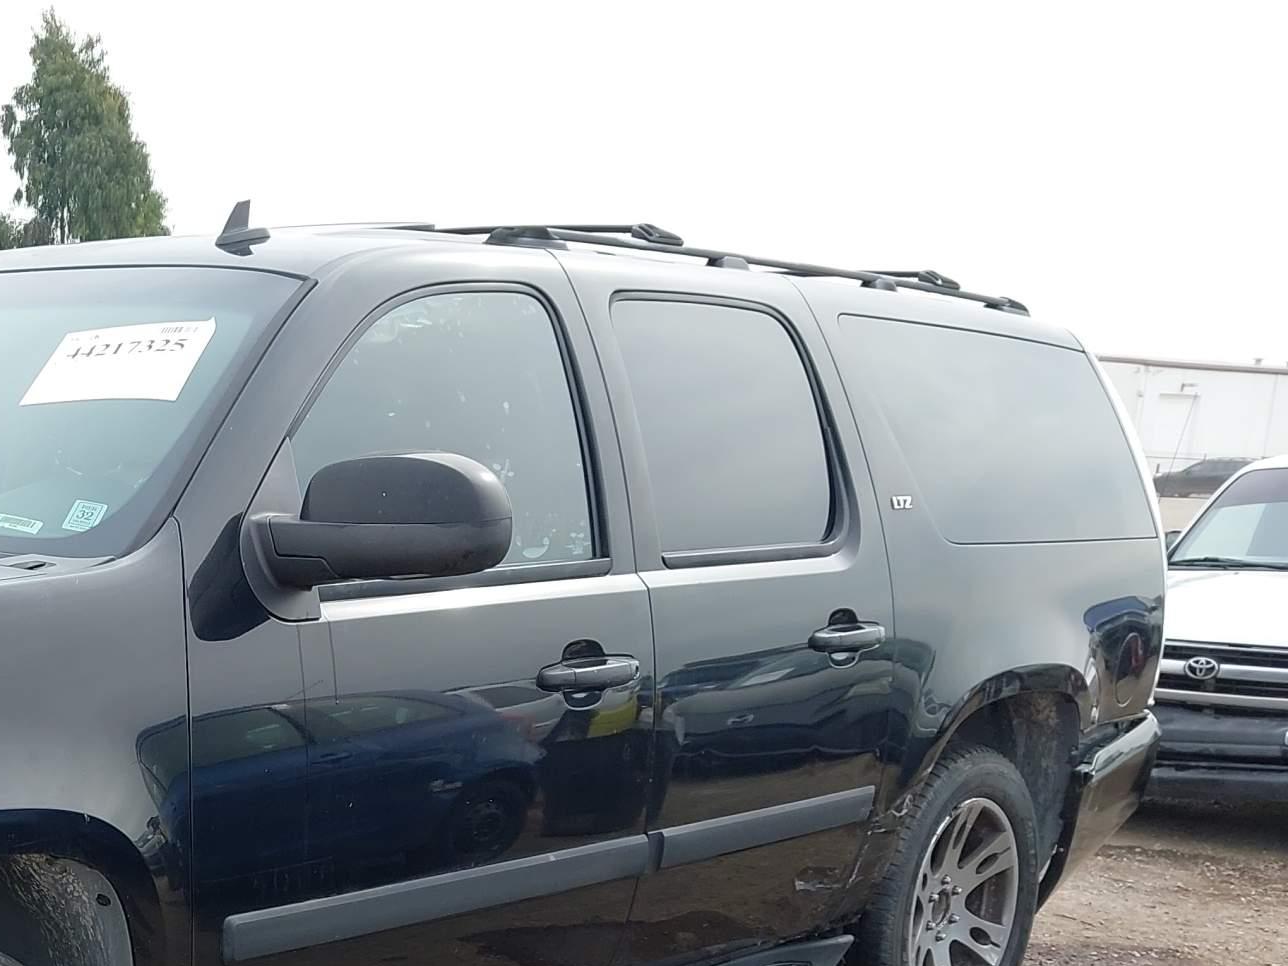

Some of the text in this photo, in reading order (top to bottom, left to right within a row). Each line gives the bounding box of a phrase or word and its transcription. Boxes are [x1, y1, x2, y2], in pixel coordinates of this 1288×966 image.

[66, 338, 189, 359] 44217325
[890, 495, 912, 509] LTZ
[75, 509, 94, 520] 32
